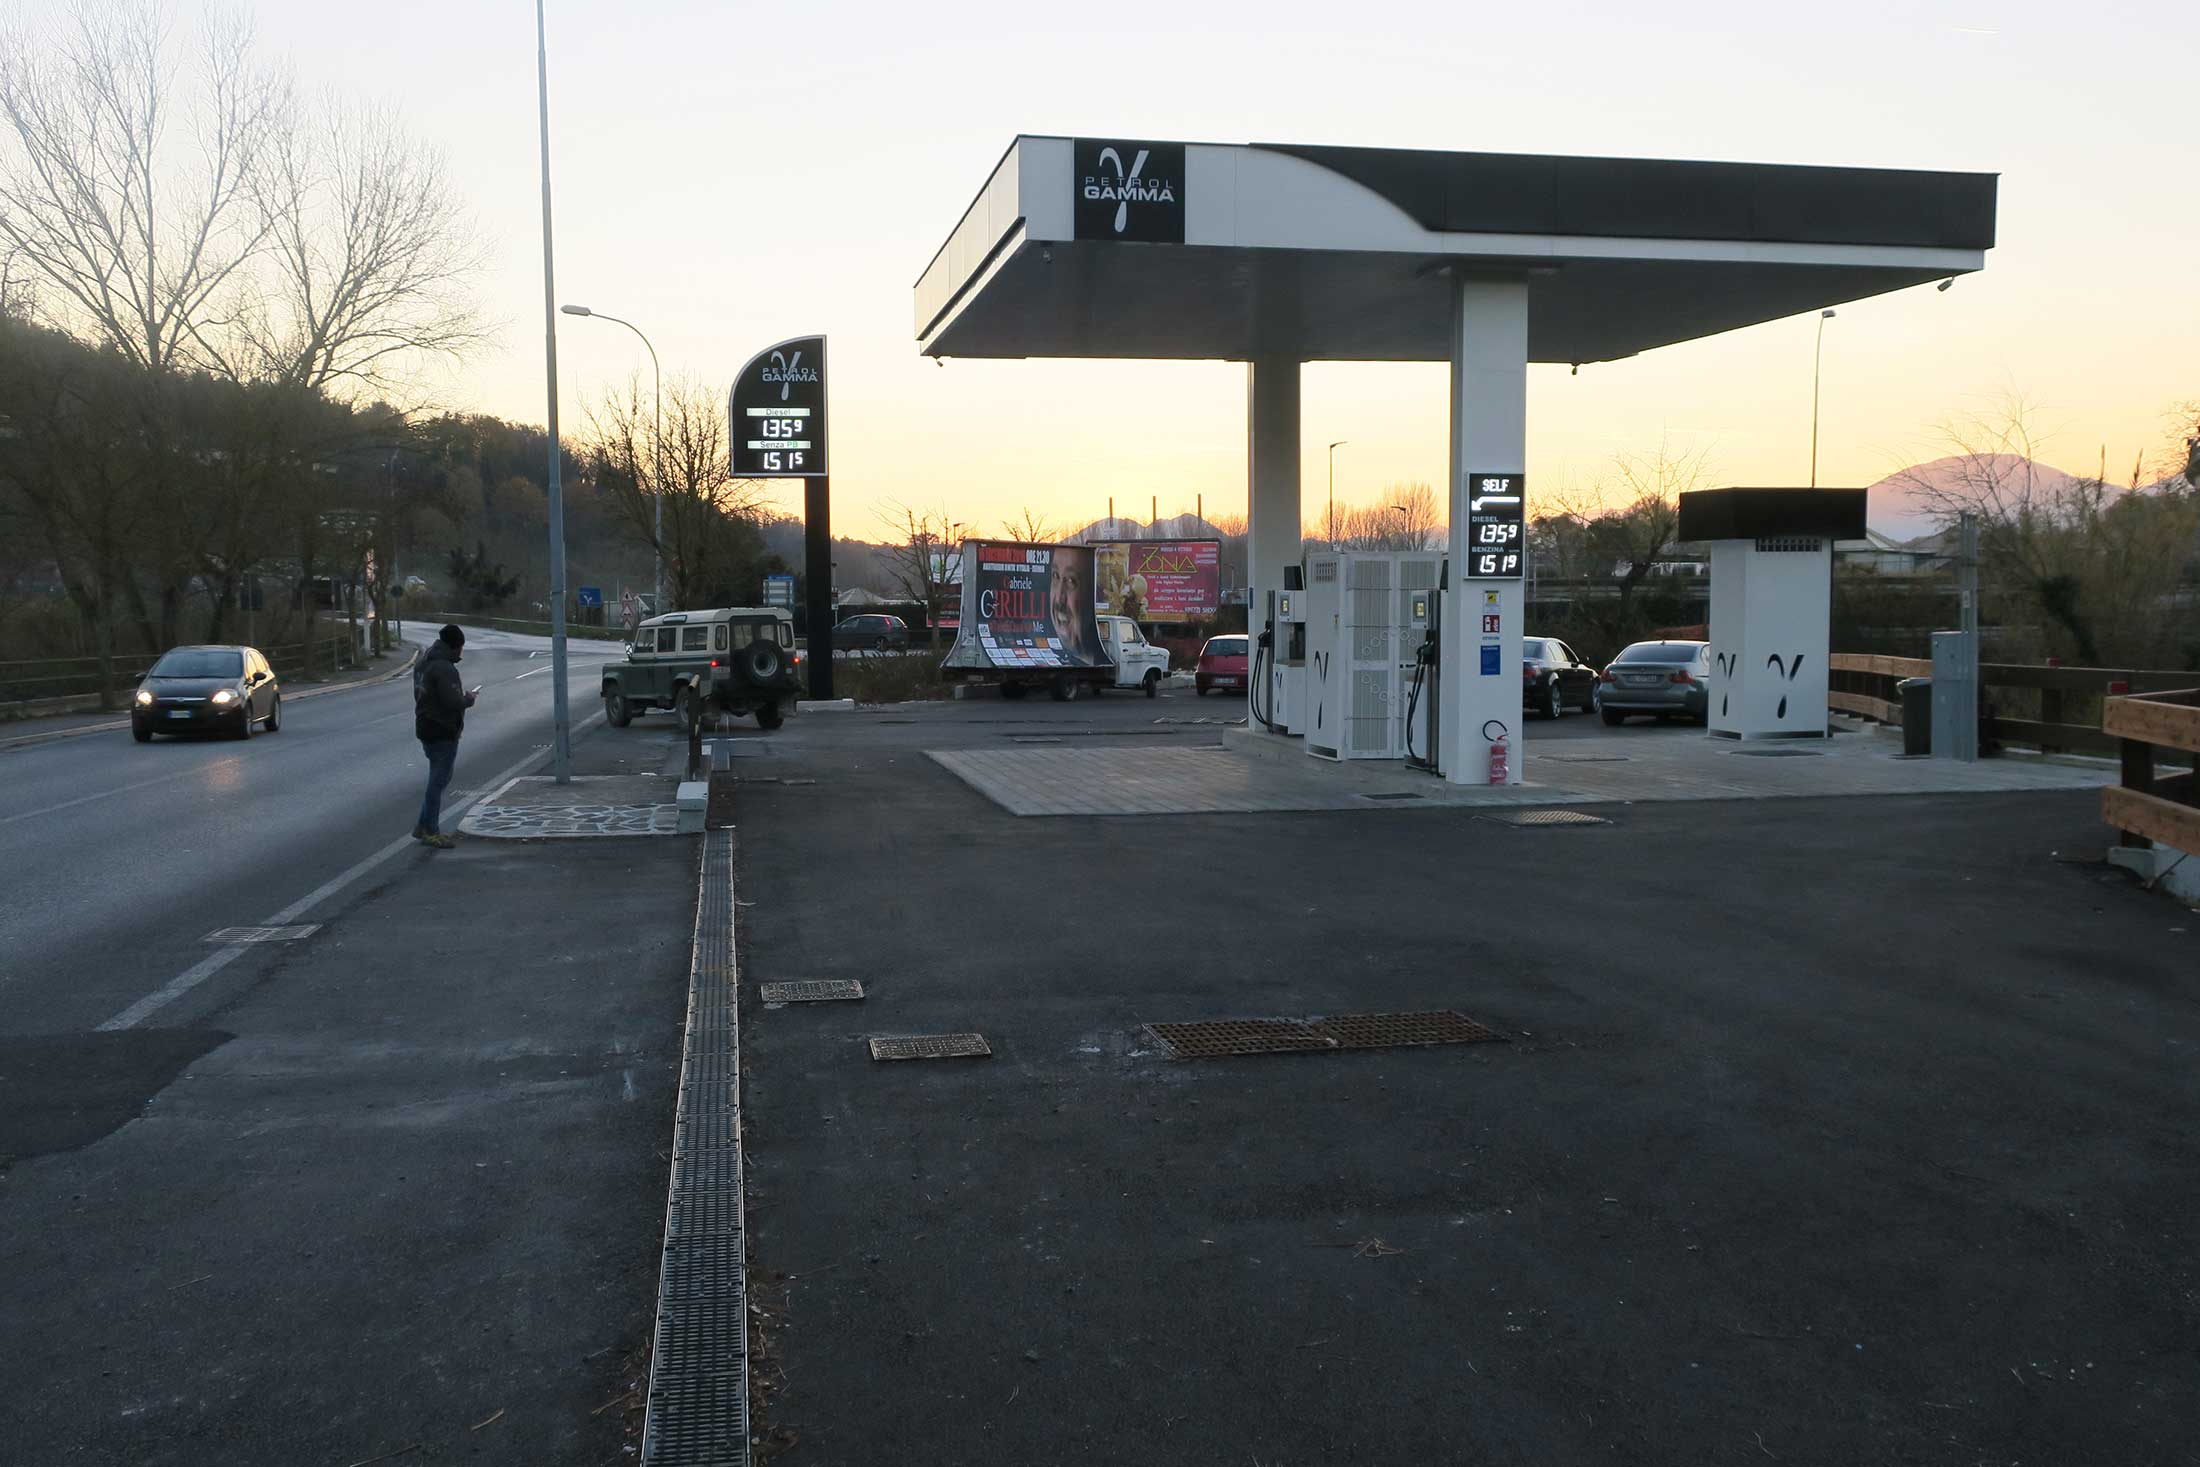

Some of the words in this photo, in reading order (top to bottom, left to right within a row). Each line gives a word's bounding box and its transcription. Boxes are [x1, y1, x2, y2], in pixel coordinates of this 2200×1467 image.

[1085, 176, 1173, 189] PETROL
[1084, 186, 1175, 202] GAMMA
[762, 373, 818, 382] GAMMA
[766, 408, 791, 416] Diesel
[1482, 478, 1510, 492] SELF
[1471, 515, 1499, 523] DIESEL
